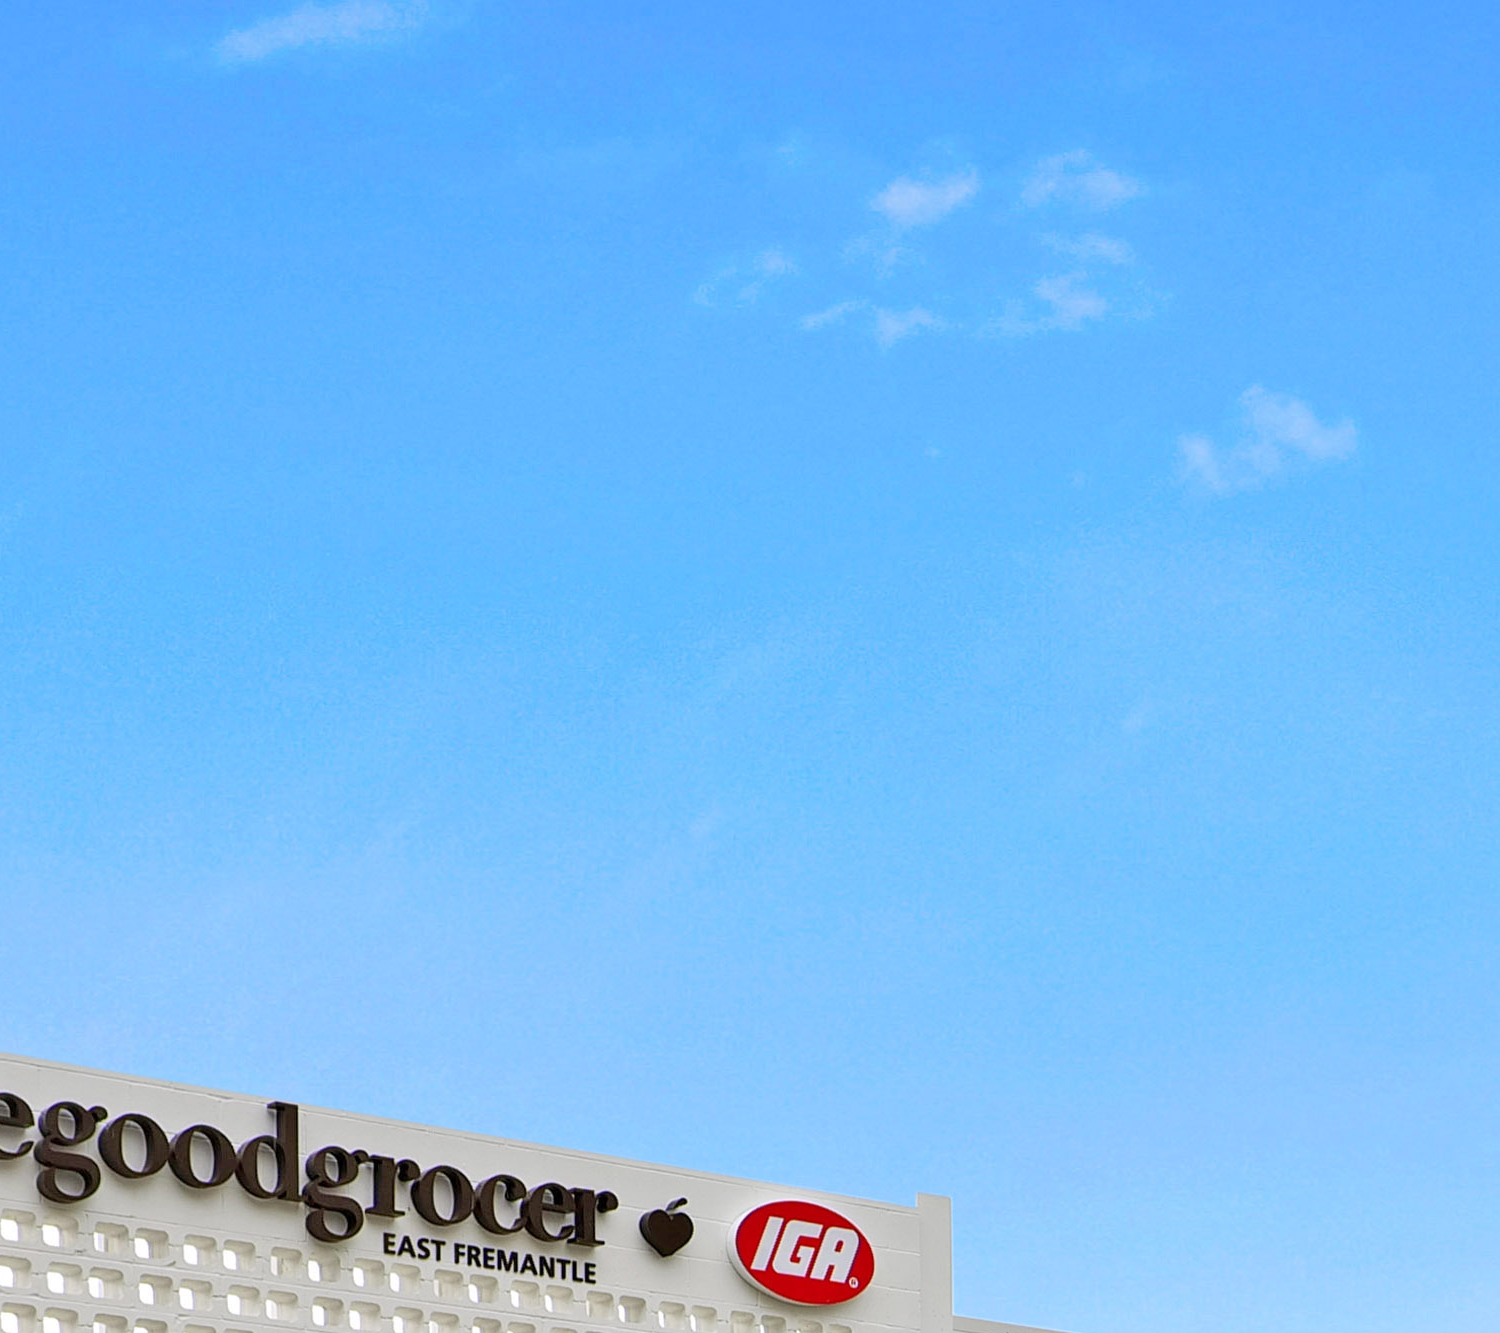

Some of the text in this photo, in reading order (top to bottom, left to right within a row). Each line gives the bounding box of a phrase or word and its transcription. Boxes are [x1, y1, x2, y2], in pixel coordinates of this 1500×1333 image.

[382, 1232, 598, 1285] EAST FREMANTLE
[750, 1215, 861, 1286] IGA
